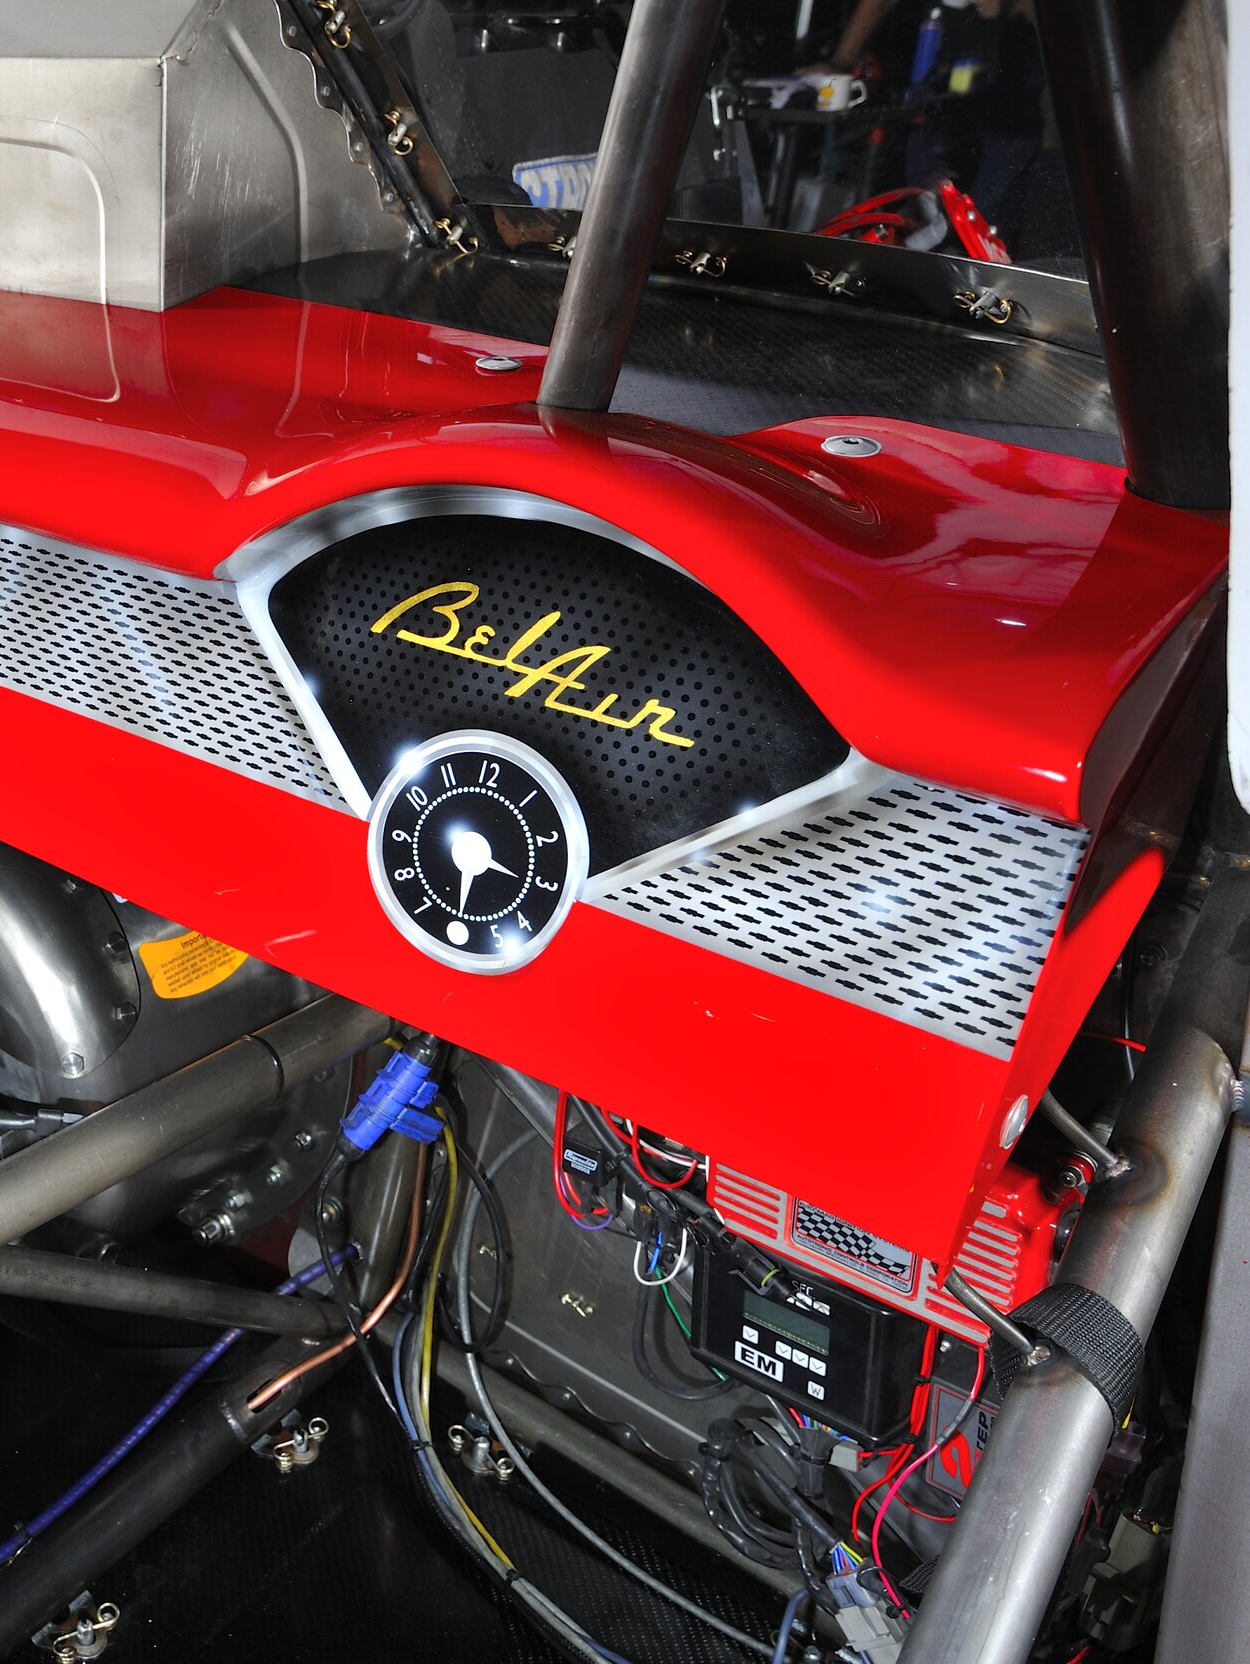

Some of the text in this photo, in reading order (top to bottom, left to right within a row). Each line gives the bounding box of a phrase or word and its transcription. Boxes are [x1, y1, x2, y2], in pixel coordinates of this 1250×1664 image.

[441, 762, 457, 788] 11
[479, 760, 500, 788] 12
[405, 785, 428, 812] 10
[519, 789, 538, 807] 1
[391, 829, 413, 843] 9
[535, 830, 560, 847] 2
[394, 867, 415, 881] 8
[535, 875, 559, 892] 3
[413, 896, 433, 915] 7
[516, 910, 533, 932] 4
[490, 924, 505, 948] 5
[797, 1234, 908, 1287] AUTOTRONIC CONTROLS CORPORATION
[741, 1346, 776, 1377] EM
